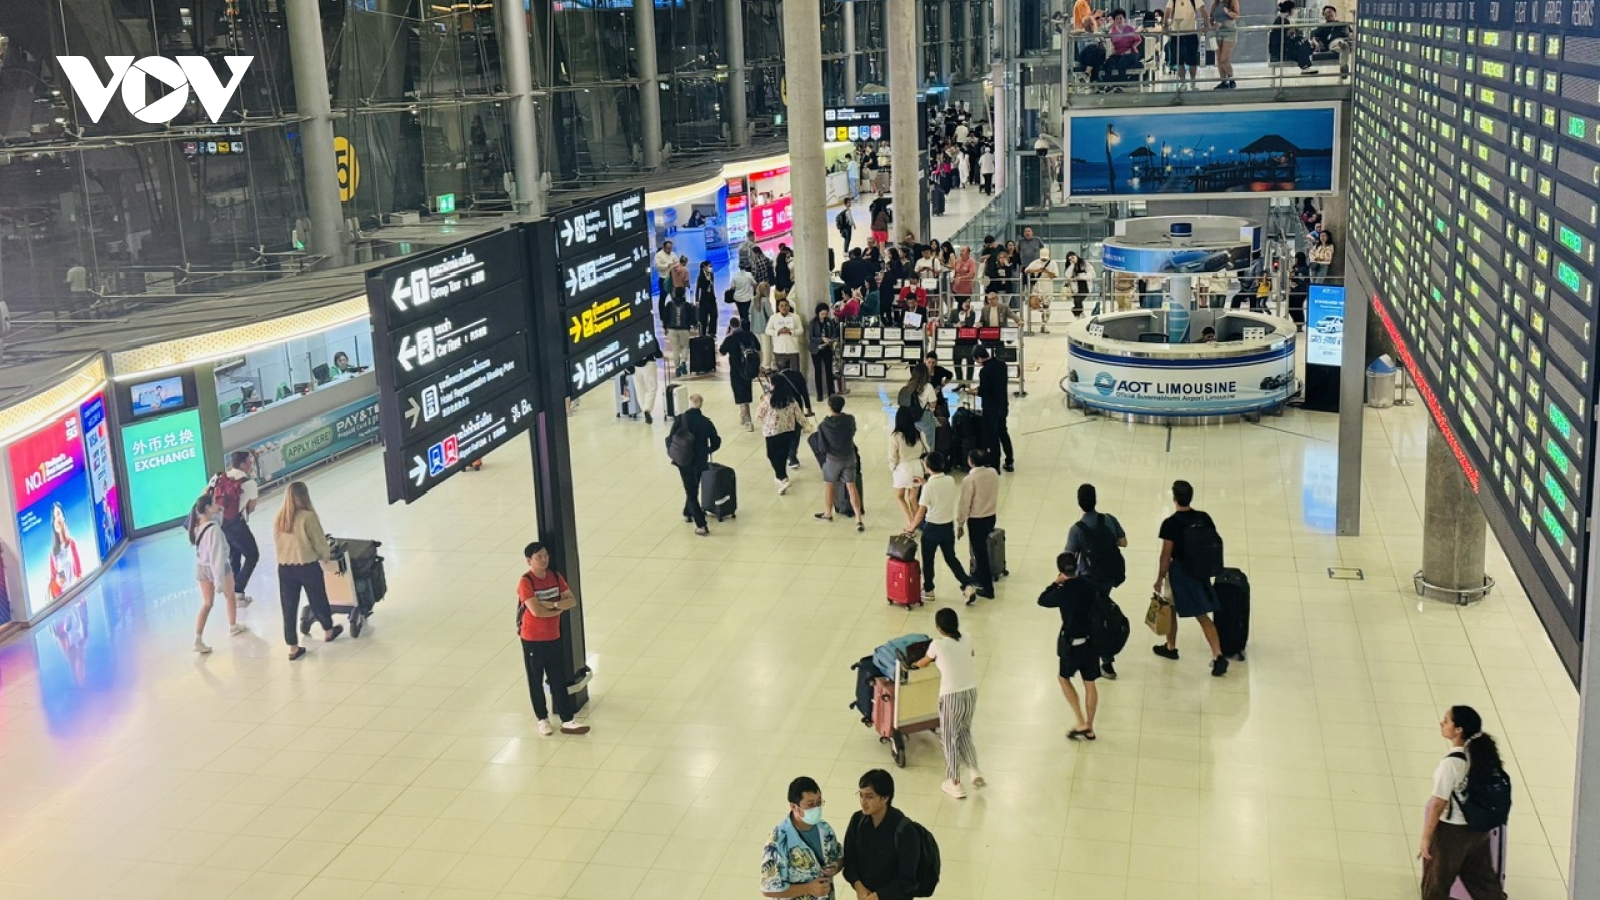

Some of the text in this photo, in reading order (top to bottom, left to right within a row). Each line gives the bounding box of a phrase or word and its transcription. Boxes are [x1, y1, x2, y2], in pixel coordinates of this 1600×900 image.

[1116, 380, 1236, 394] AOT LIMOUSINE
[1182, 393, 1204, 402] Airport
[1205, 393, 1235, 401] Limousine
[132, 428, 195, 455] 外币兑换
[288, 430, 331, 458] APPLY HERE!
[134, 447, 196, 473] EXCHANGE
[25, 461, 47, 495] NO.1
